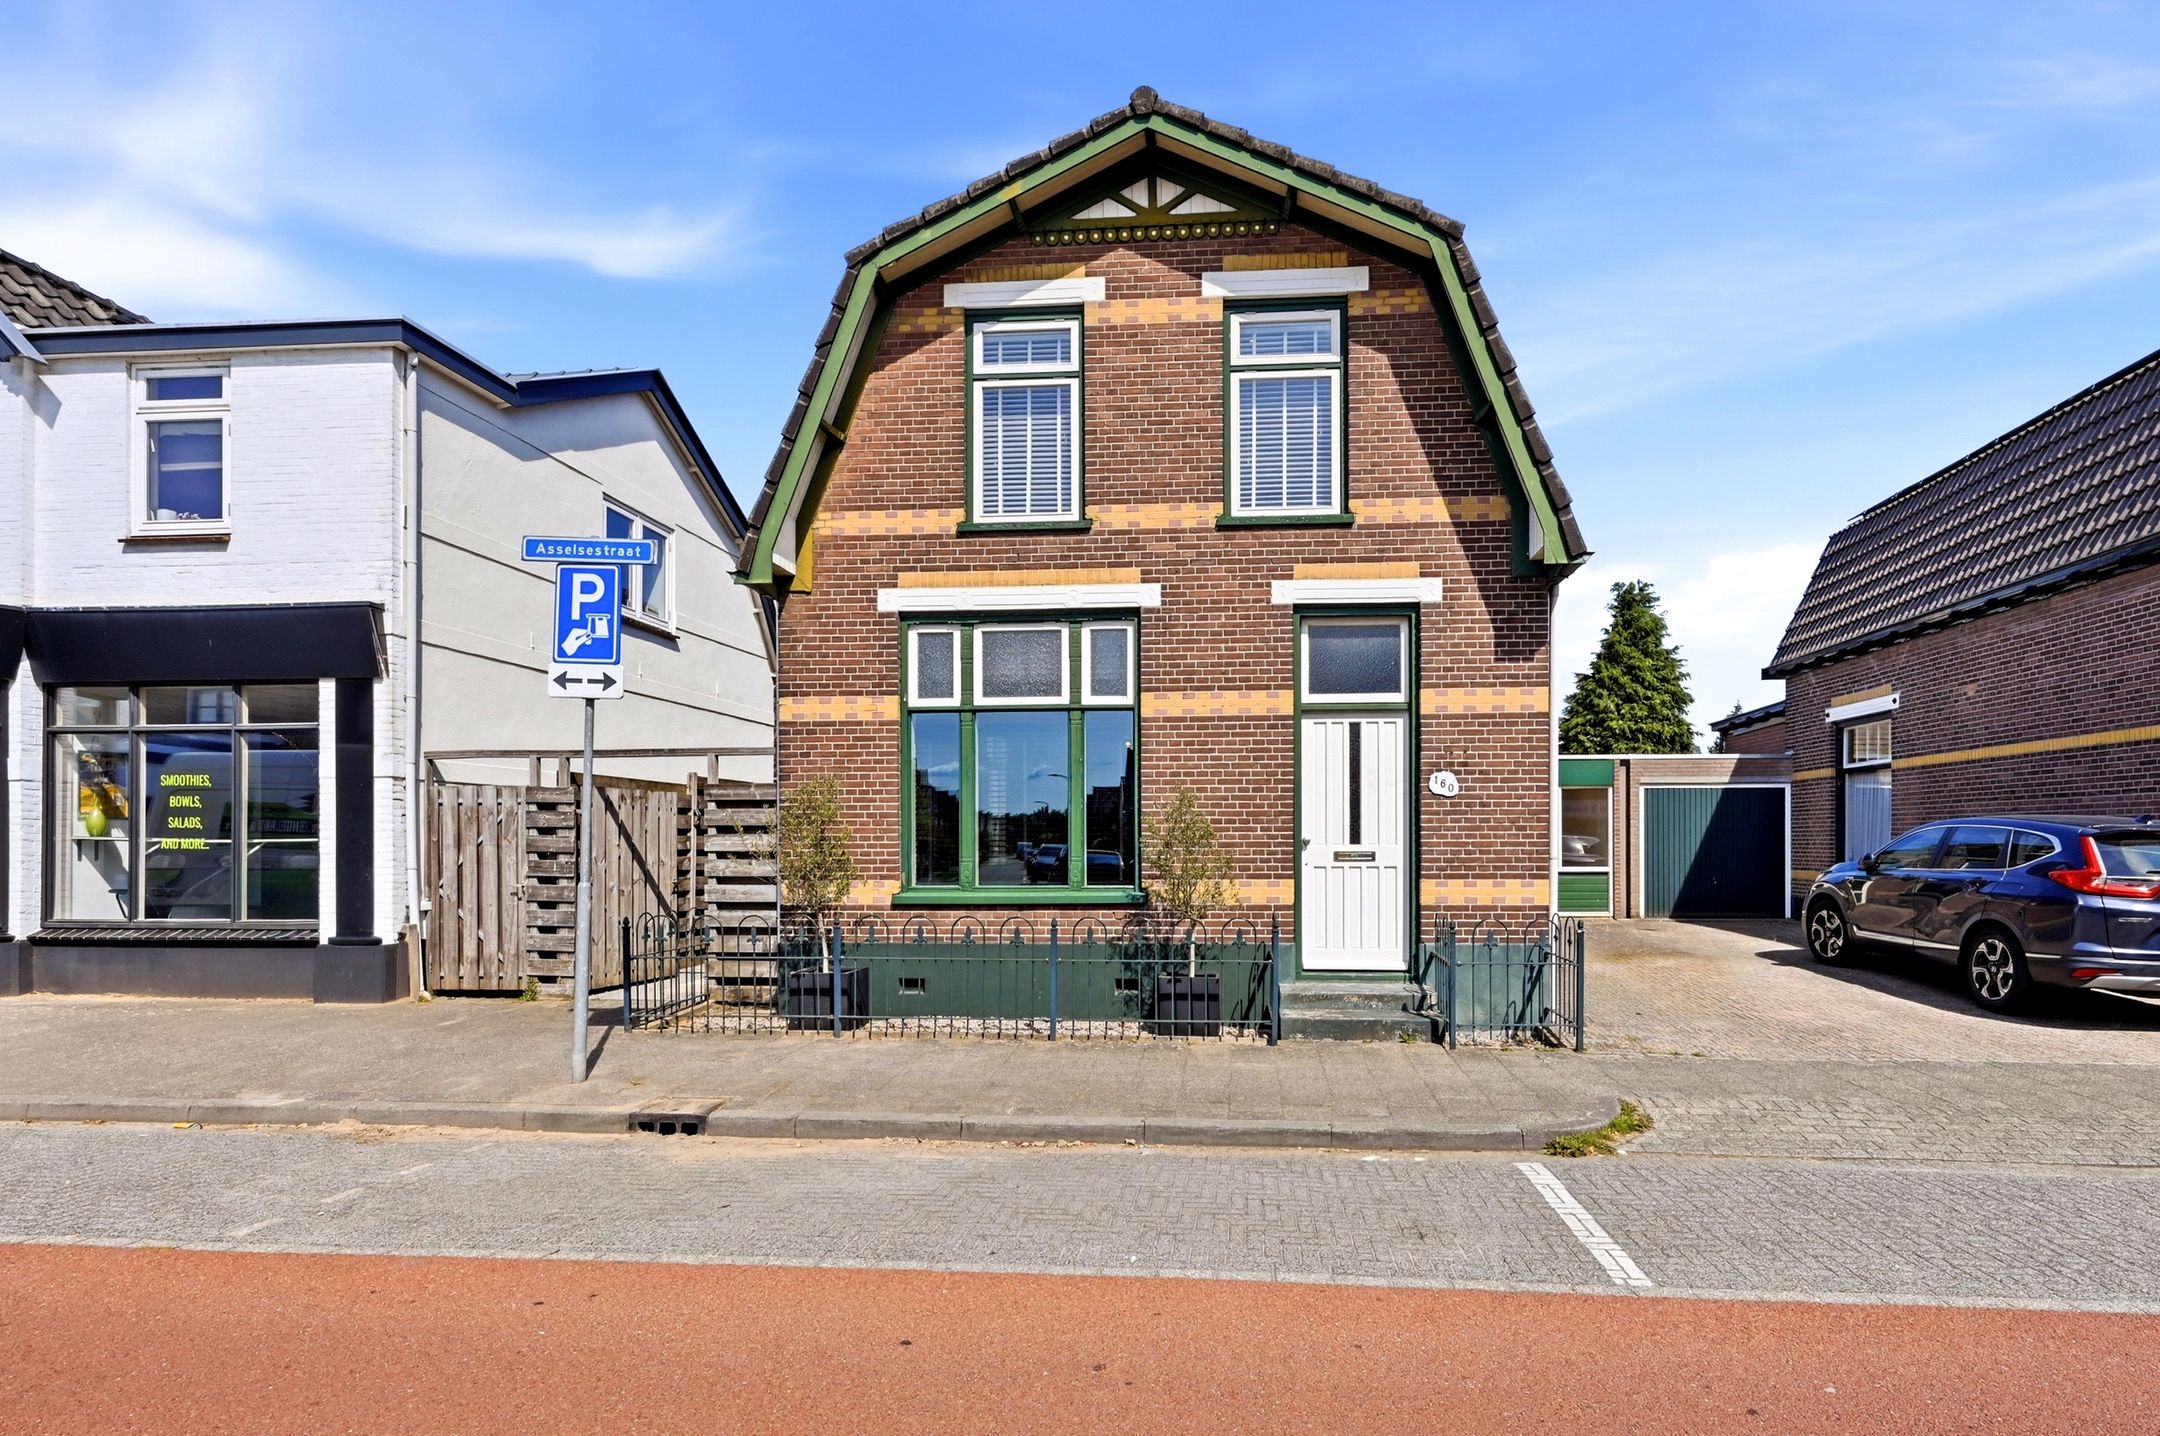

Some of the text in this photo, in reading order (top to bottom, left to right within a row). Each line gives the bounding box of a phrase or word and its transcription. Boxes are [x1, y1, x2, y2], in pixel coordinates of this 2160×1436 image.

[536, 542, 641, 557] Asselsestraat
[571, 572, 605, 620] P
[160, 774, 212, 788] SMOOTHIES,
[1434, 775, 1454, 793] 160
[169, 795, 202, 809] BOWLS,
[168, 816, 203, 830] SALADS,
[160, 838, 179, 850] AND
